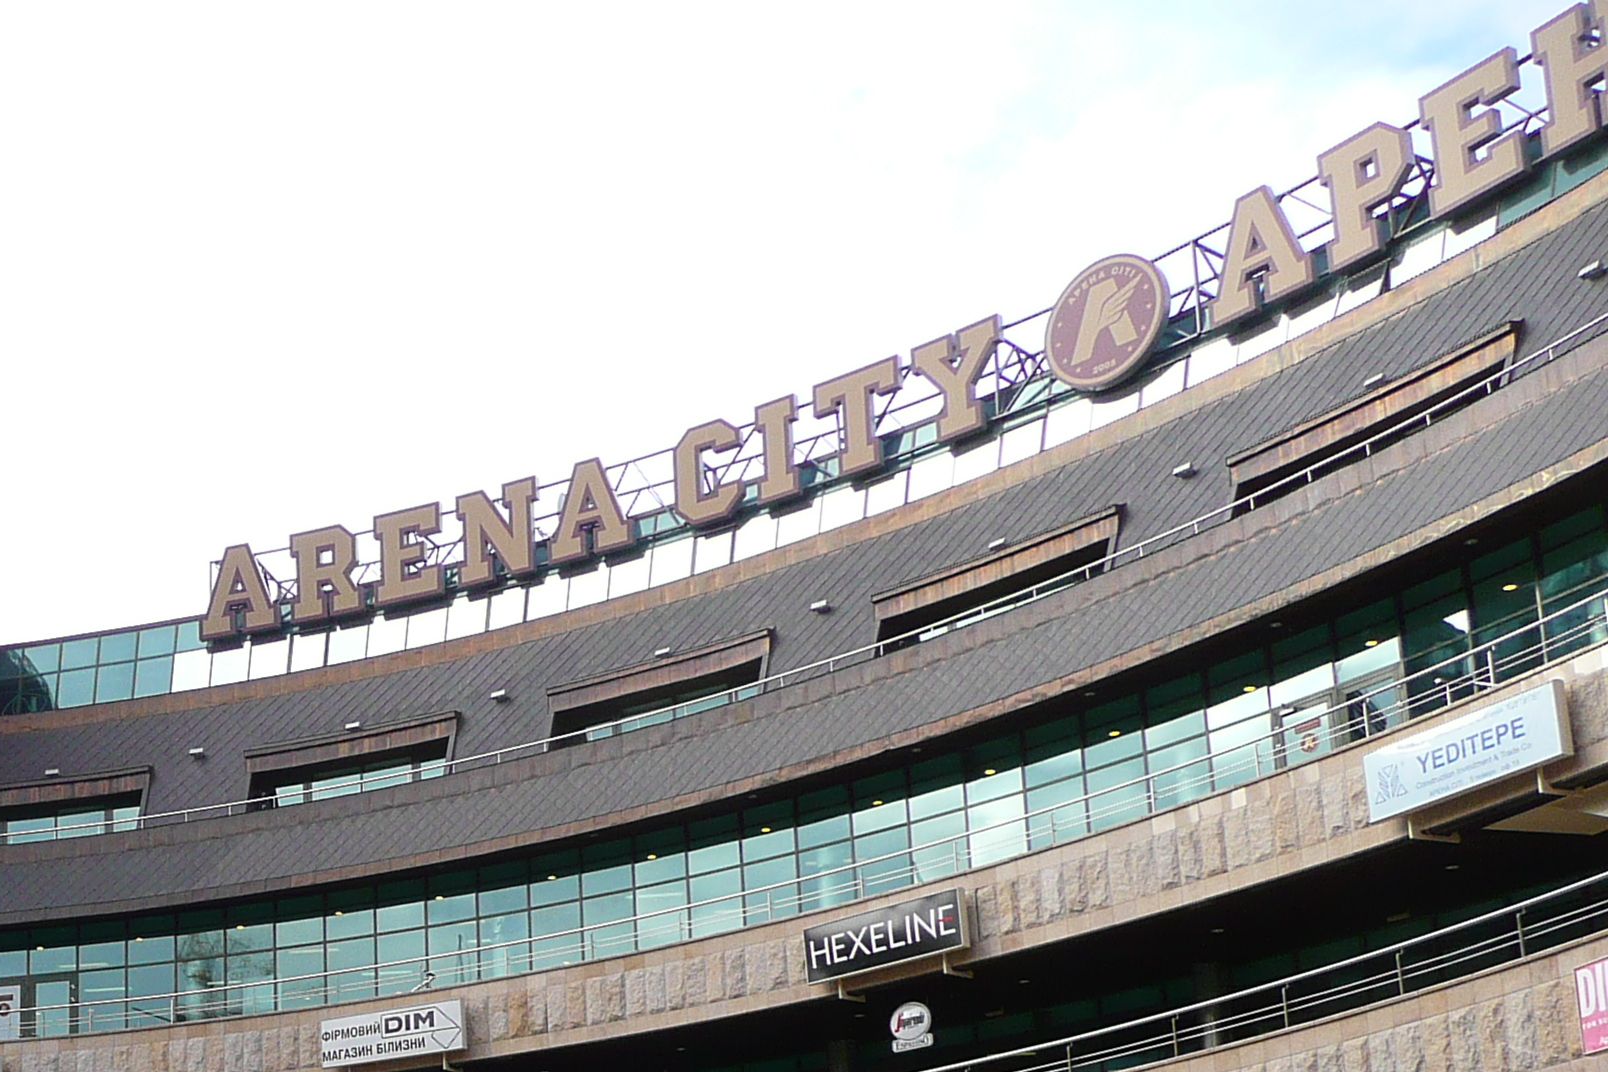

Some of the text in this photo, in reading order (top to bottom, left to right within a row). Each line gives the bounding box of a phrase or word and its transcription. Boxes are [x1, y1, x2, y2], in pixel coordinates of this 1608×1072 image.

[198, 312, 1004, 642] ARENA CITY
[1416, 716, 1525, 774] YEDITEPE
[809, 903, 957, 969] HEXELINE
[1575, 961, 1608, 1018] DI
[322, 1010, 435, 1042] ФІРМОВИЙ DIM
[322, 1037, 426, 1062] МАГАЗИН БІЛИЗНИ
